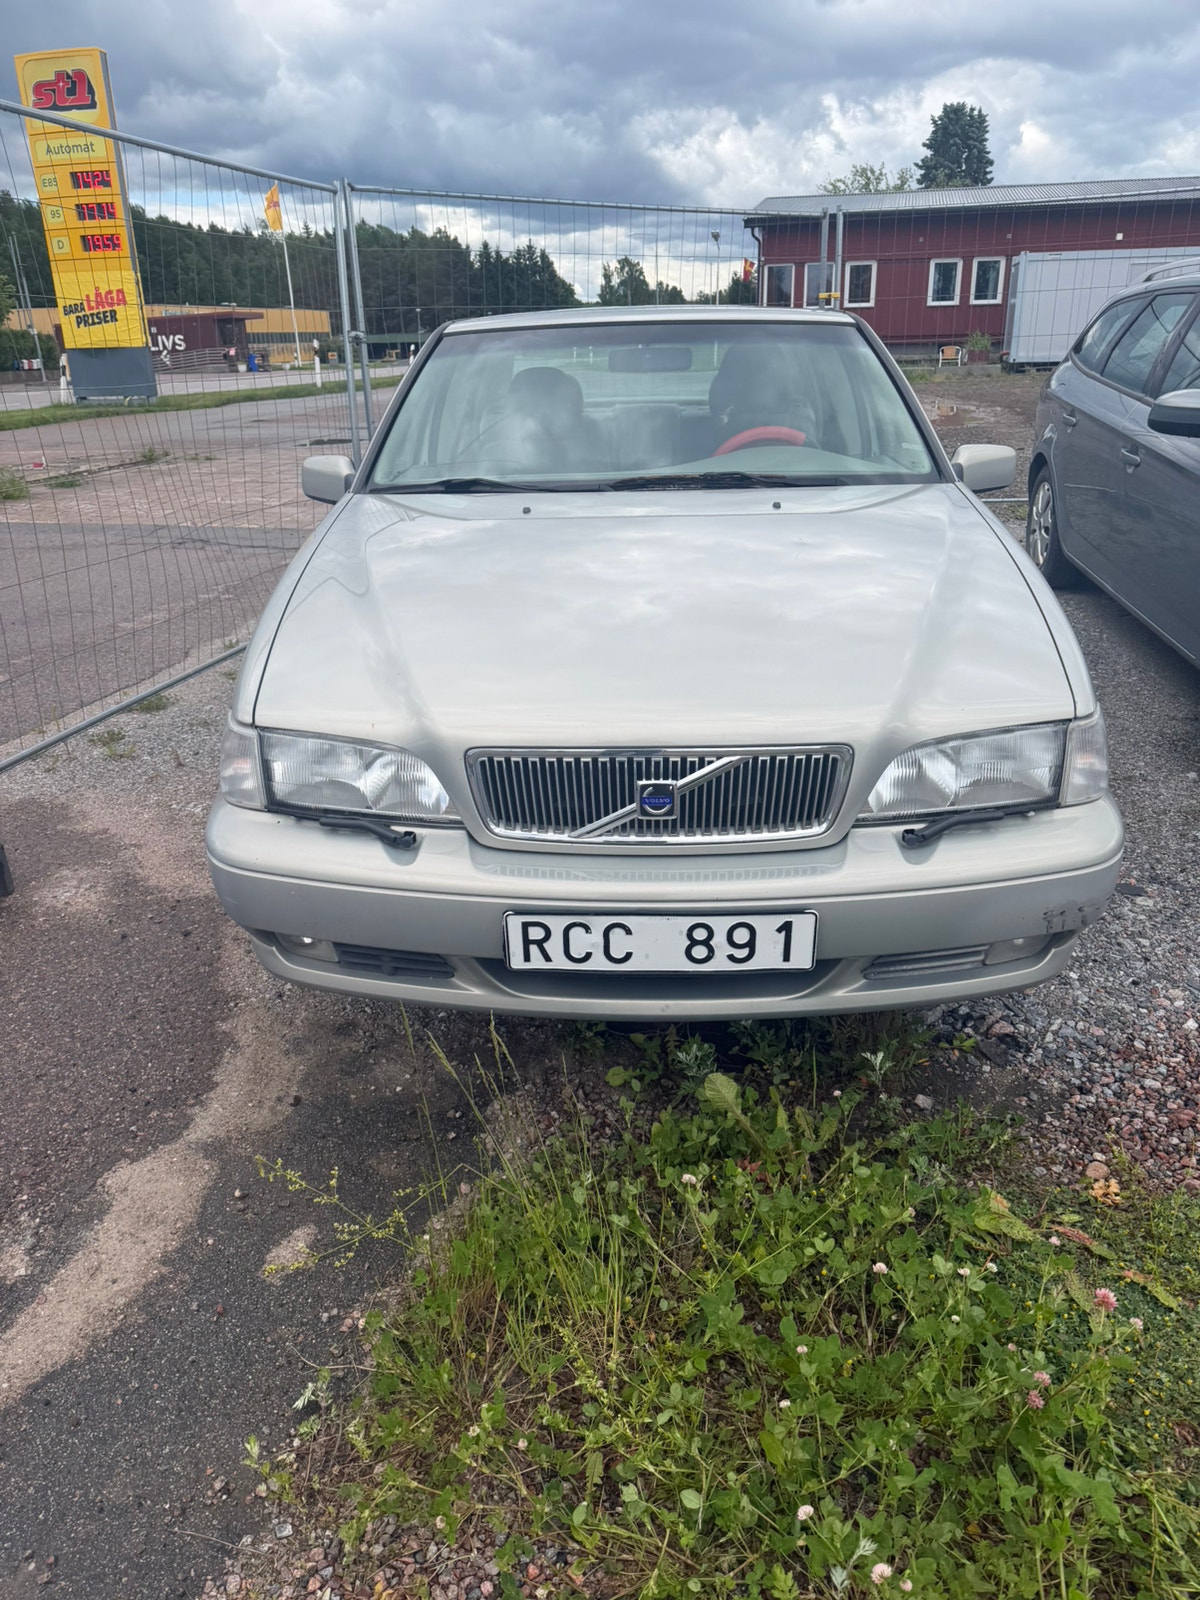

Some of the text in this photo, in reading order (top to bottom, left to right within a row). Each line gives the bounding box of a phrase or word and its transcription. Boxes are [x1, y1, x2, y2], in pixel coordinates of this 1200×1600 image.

[32, 69, 97, 109] st1
[46, 141, 96, 156] Automat
[42, 177, 58, 188] E85
[50, 209, 61, 219] 95
[57, 239, 65, 250] D
[62, 286, 127, 316] BARA LÅGA
[75, 309, 118, 329] PRISER
[520, 919, 793, 965] RCC 891
